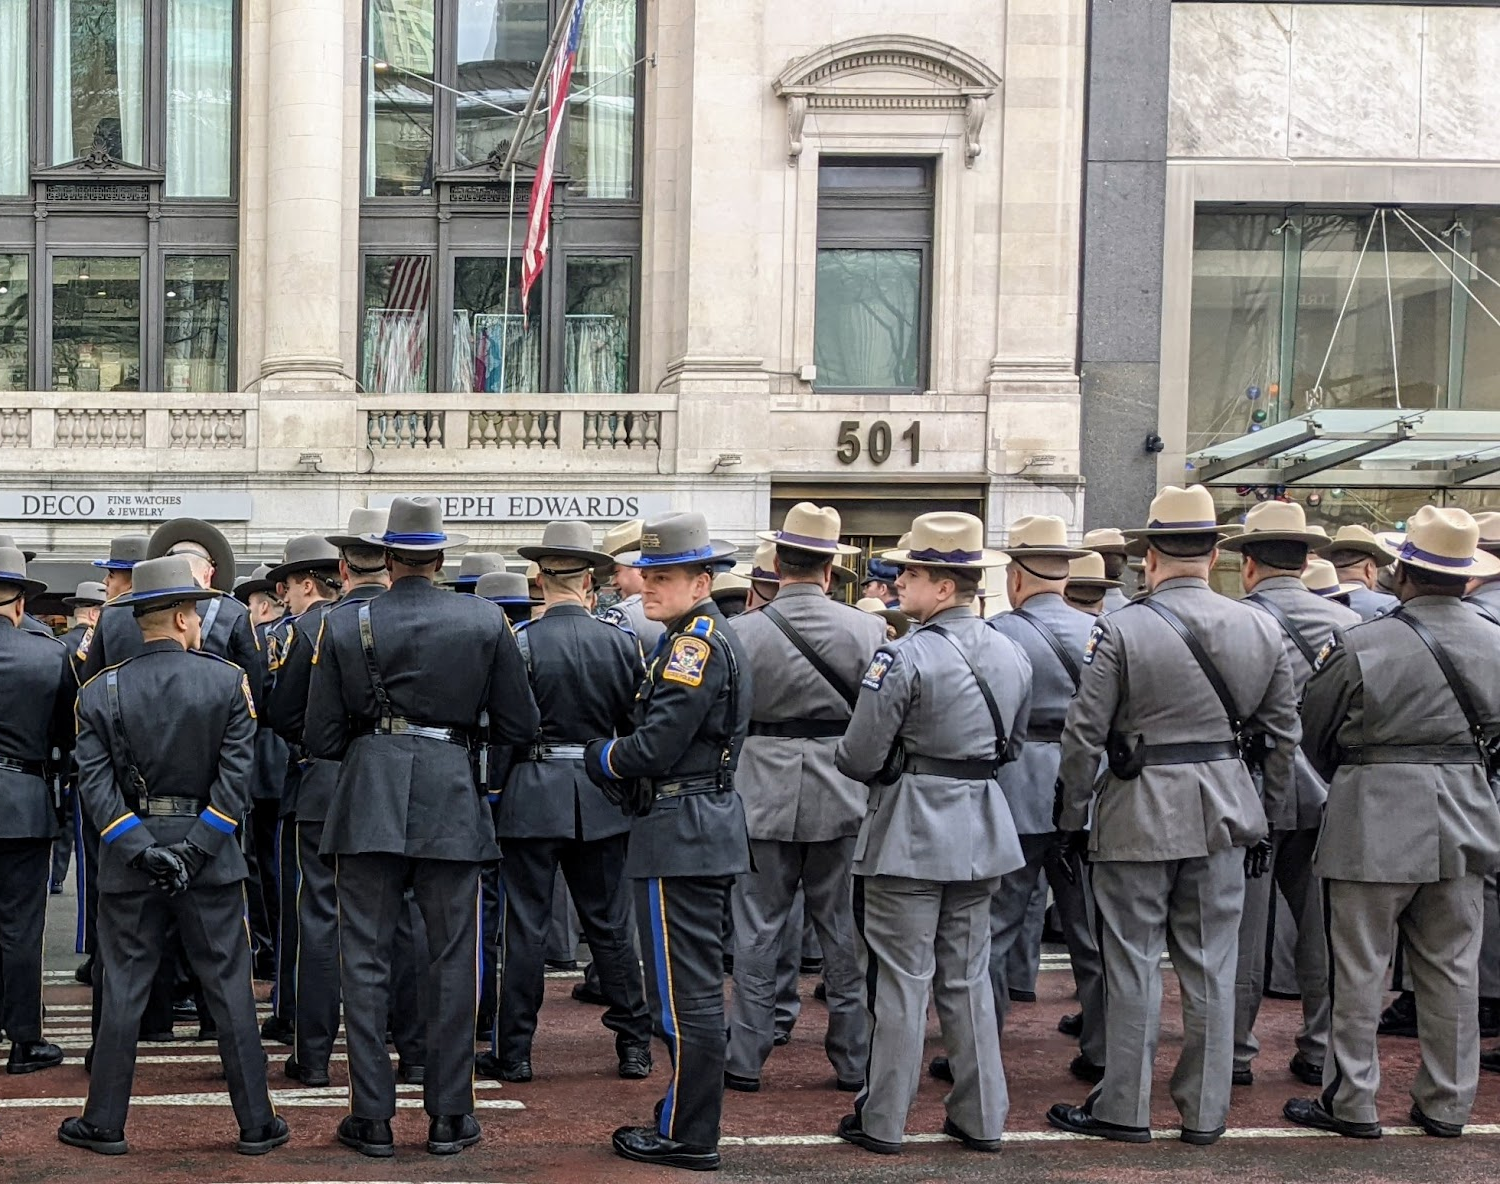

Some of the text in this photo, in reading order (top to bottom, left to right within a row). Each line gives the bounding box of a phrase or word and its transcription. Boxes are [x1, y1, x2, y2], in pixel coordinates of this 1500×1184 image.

[837, 420, 921, 466] 501
[21, 495, 182, 516] DECO FINE WATCHES
[107, 507, 165, 517] & JEWELRY
[508, 496, 639, 518] EDWARDS
